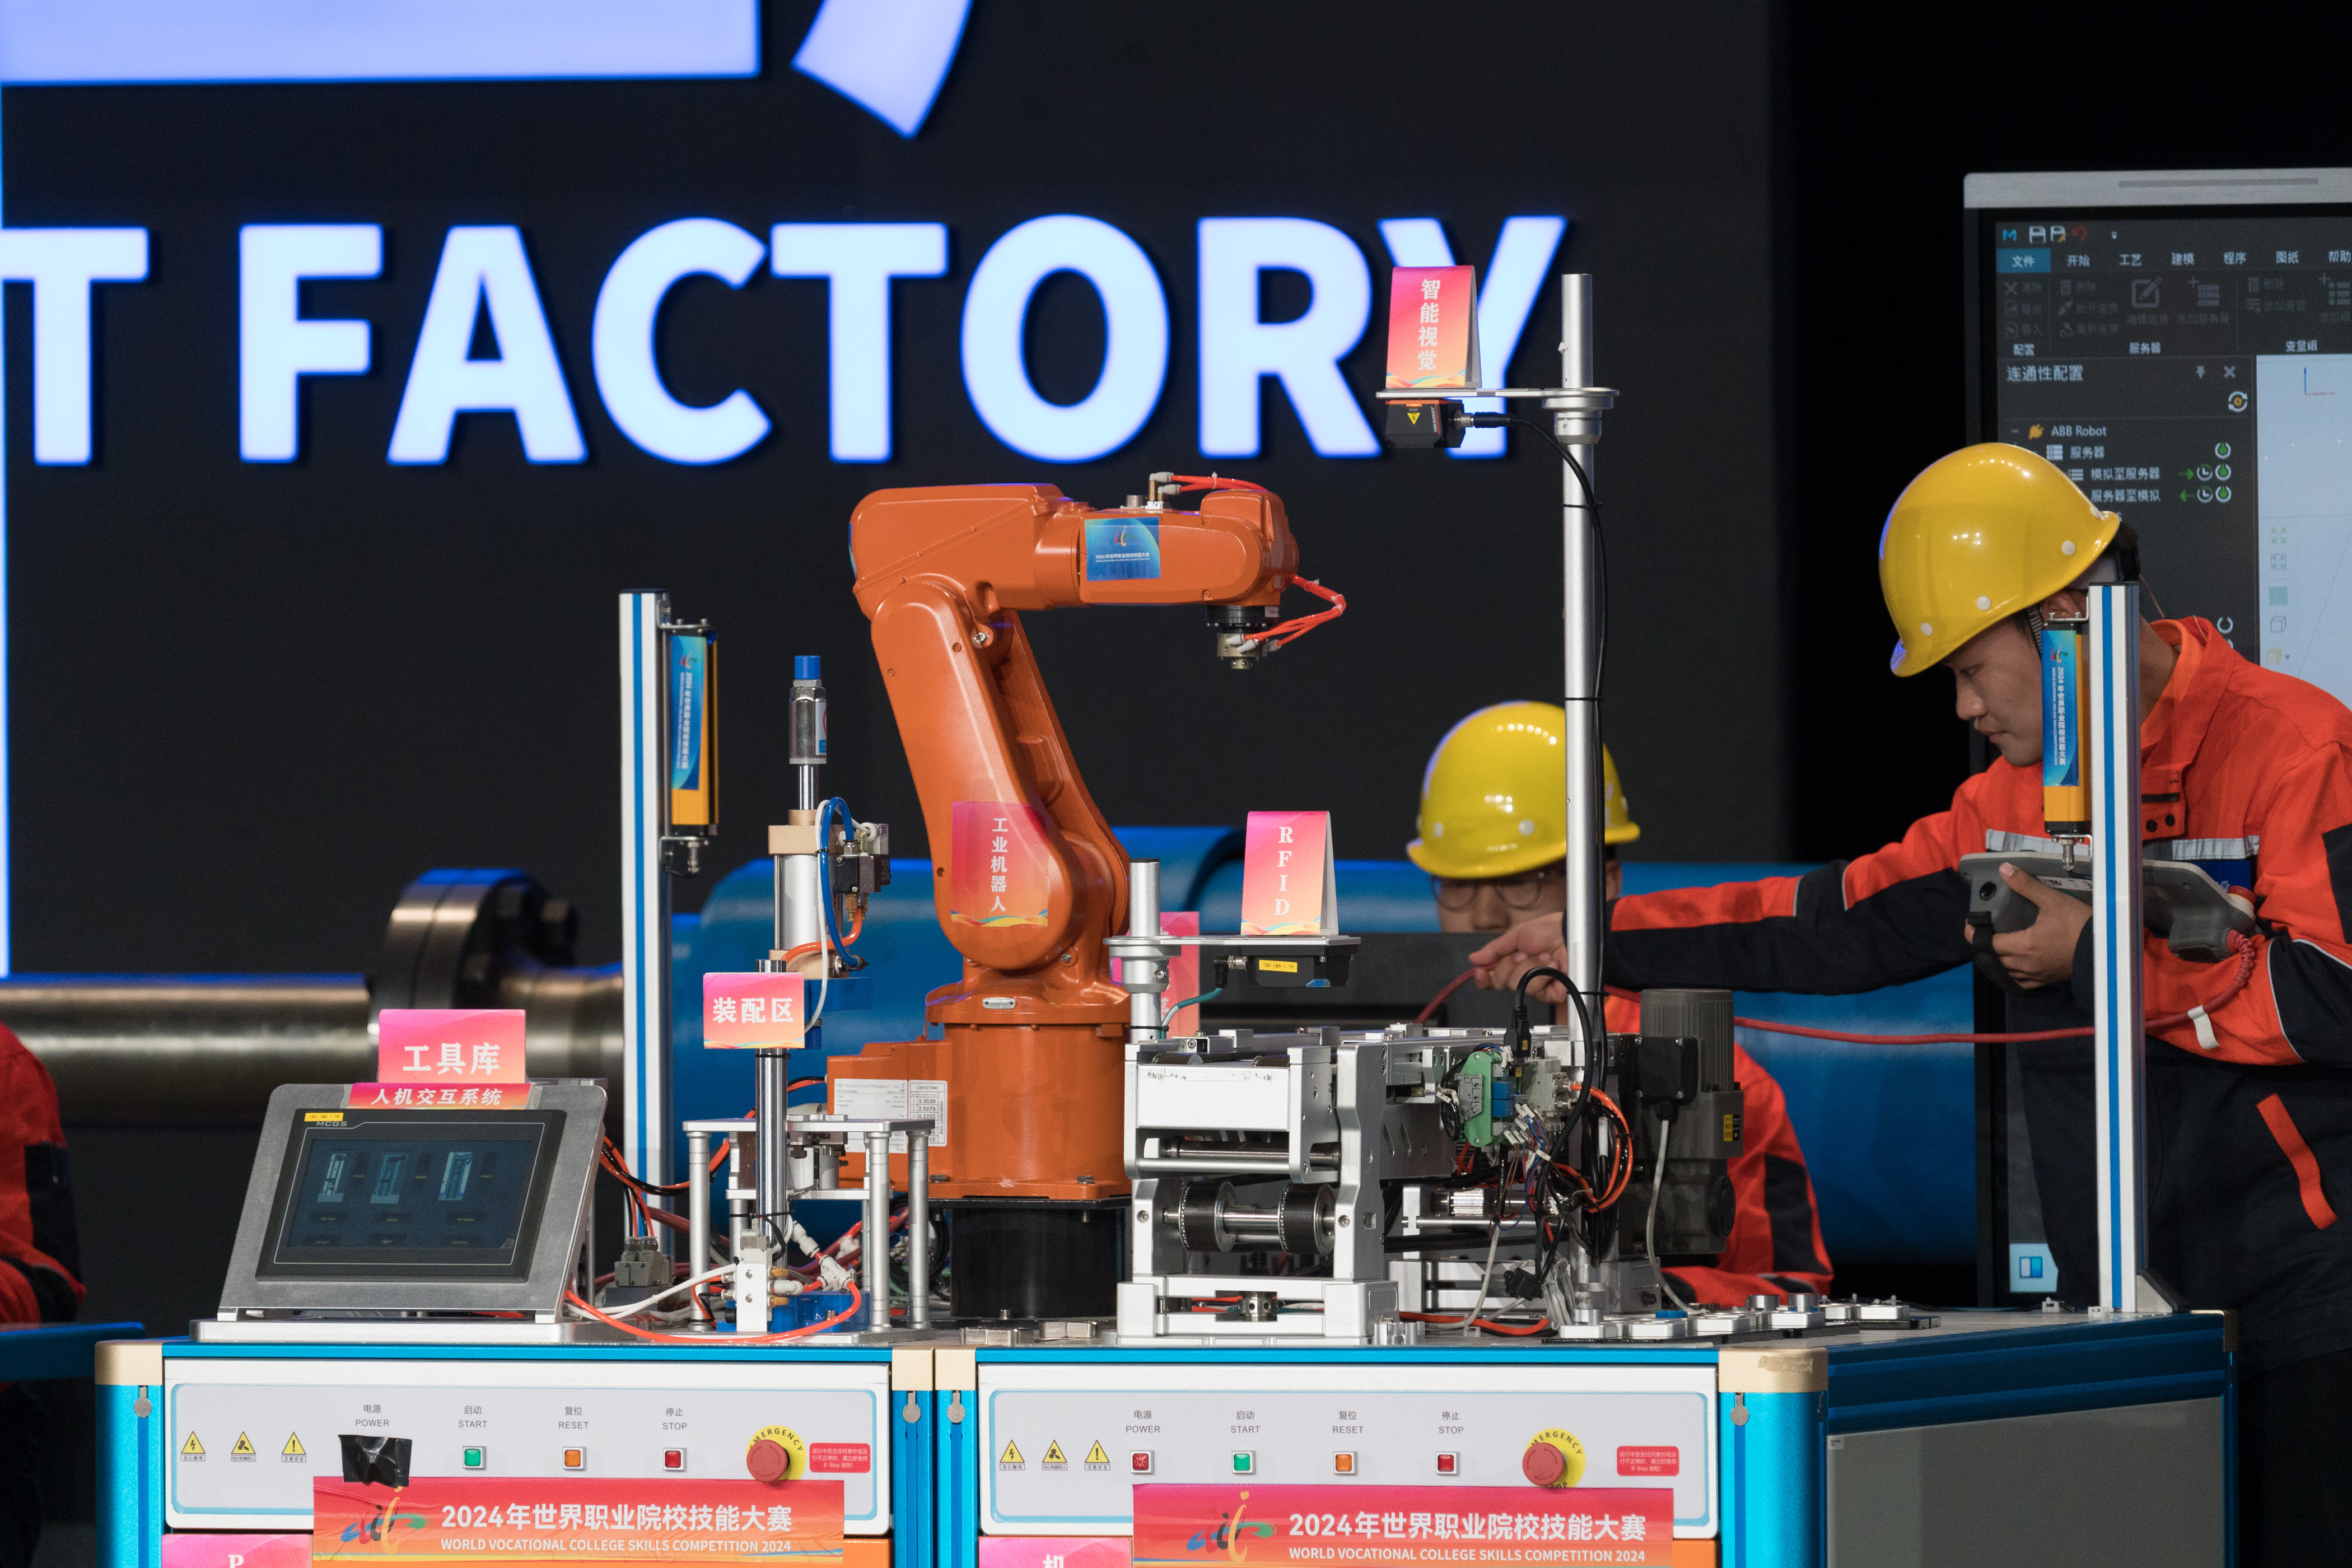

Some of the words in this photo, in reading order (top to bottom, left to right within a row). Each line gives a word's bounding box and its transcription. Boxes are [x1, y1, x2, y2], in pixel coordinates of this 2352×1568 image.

[2012, 255, 2036, 267] 文件
[2066, 255, 2090, 267] 开始
[2119, 254, 2142, 266] 工艺
[2171, 253, 2195, 265] 建模
[2223, 252, 2247, 264] 程序
[2276, 251, 2299, 264] 图纸
[2328, 250, 2351, 263] 帮助
[1417, 278, 1441, 371] 智能视觉
[240, 214, 1567, 464] FACTORY
[2129, 342, 2161, 354] 服务器
[2006, 366, 2084, 381] 连通性配置
[2051, 426, 2073, 437] ABB
[2075, 425, 2107, 437] Robot
[2070, 446, 2105, 459] 服务器
[990, 817, 1009, 912] 工业机器人
[1274, 827, 1294, 916] RFID
[712, 997, 794, 1024] 装配区
[403, 1042, 500, 1075] 工具库
[370, 1088, 502, 1107] 人机交互系统
[363, 1404, 381, 1413] 电源
[464, 1405, 482, 1415] 启动
[564, 1406, 583, 1416] 复位
[665, 1407, 684, 1417] 停止
[1133, 1410, 1152, 1419] 电源
[1236, 1410, 1254, 1420] 启动
[1338, 1410, 1357, 1420] 复位
[1441, 1411, 1460, 1421] 停止
[355, 1418, 390, 1427] POWER
[458, 1420, 487, 1428] START
[558, 1421, 589, 1430] RESET
[662, 1422, 688, 1430] STOP
[1126, 1425, 1161, 1434] POWER
[1231, 1425, 1260, 1434] START
[1332, 1425, 1364, 1434] RESET
[1439, 1426, 1464, 1434] STOP
[750, 1428, 803, 1451] MERGENCY
[441, 1503, 792, 1533] 2024年世界职业院校技能大赛
[1289, 1513, 1646, 1541] 2024年世界职业院校技能大赛
[441, 1538, 486, 1551] WORLD
[488, 1538, 567, 1551] VOCATIONAL
[569, 1539, 626, 1552] COLLEGE
[628, 1539, 669, 1552] SKILLS
[672, 1539, 758, 1552] COMPETITION
[762, 1539, 791, 1552] 2024
[1289, 1547, 1335, 1560] WORLD
[1338, 1547, 1417, 1560] VOCATIONAL
[1420, 1548, 1476, 1561] COLLEGE
[1479, 1548, 1522, 1561] SKILLS
[1525, 1549, 1613, 1562] COMPETITION
[1616, 1549, 1646, 1562] 2024
